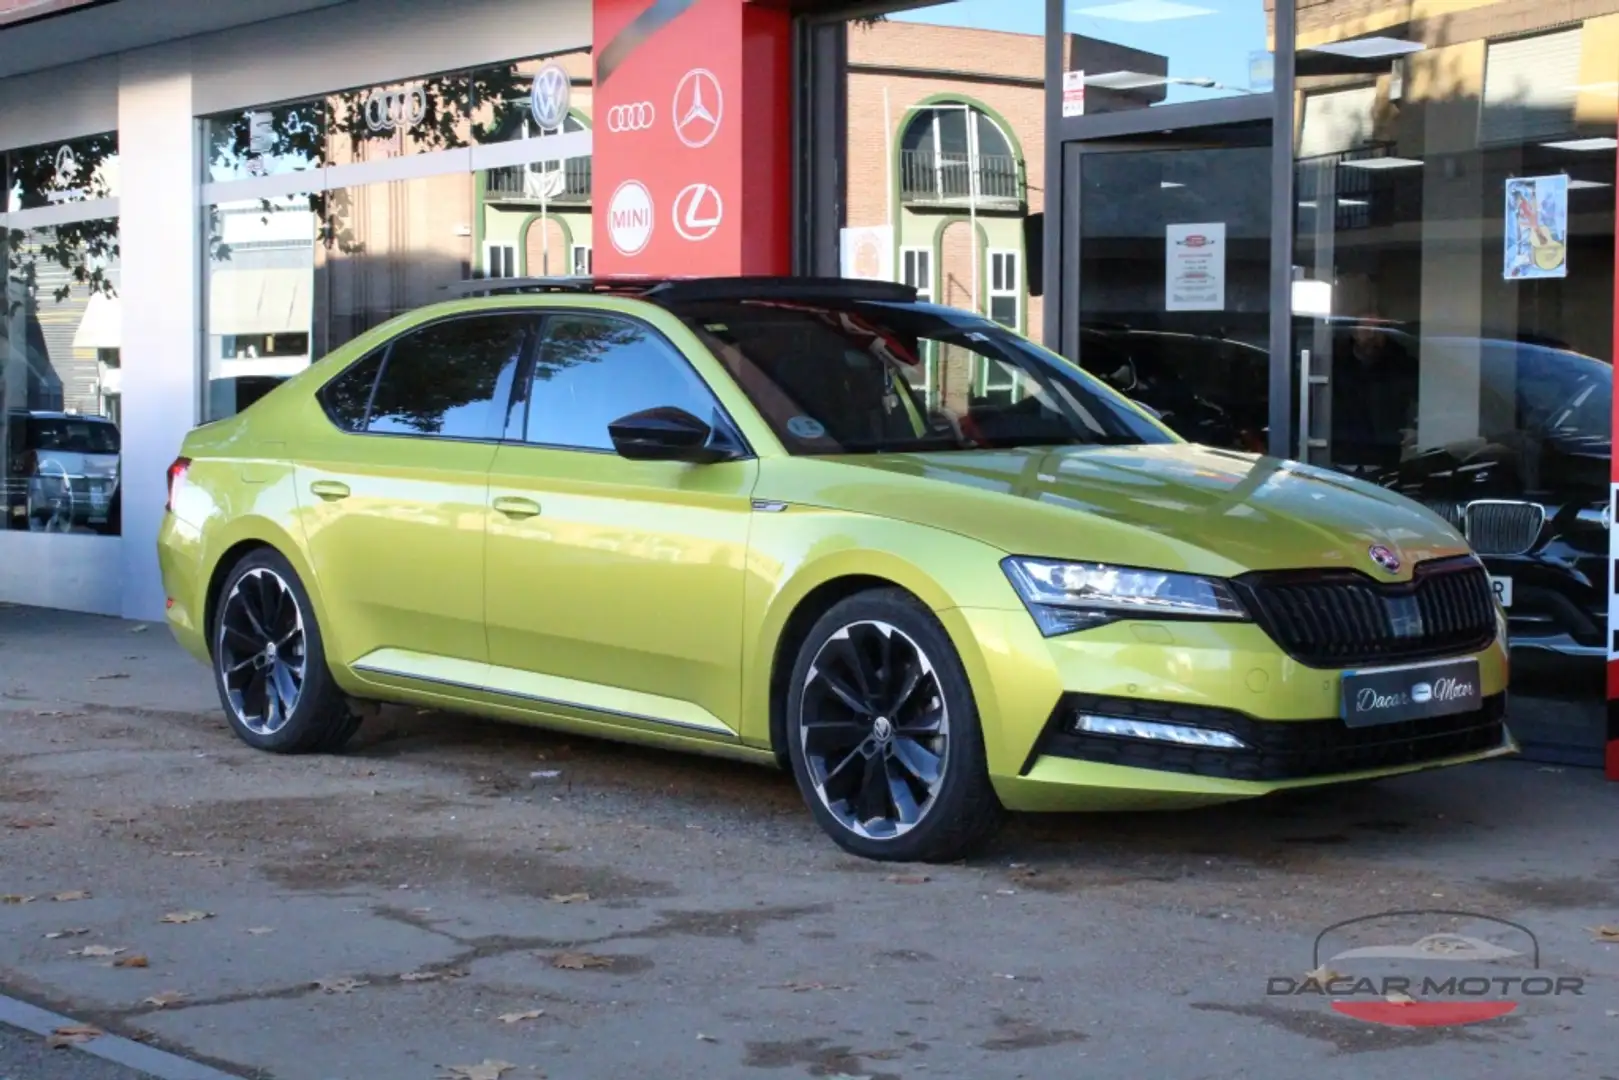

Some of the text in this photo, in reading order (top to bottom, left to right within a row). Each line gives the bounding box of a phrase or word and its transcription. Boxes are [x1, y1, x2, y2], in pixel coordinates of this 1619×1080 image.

[612, 208, 649, 229] MINI
[1356, 677, 1474, 712] Dacar Motor
